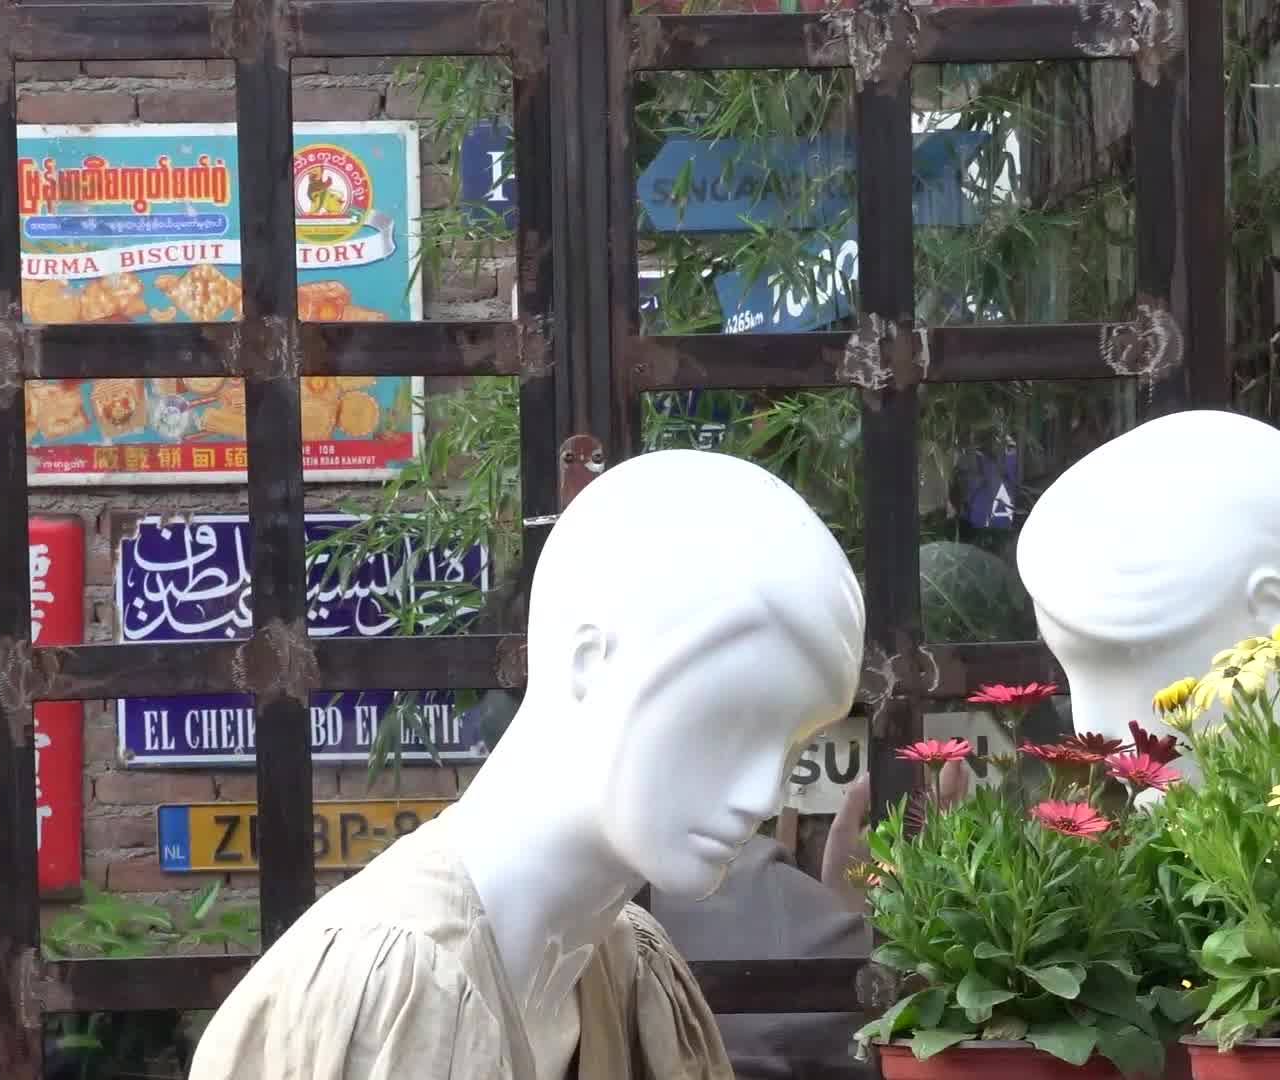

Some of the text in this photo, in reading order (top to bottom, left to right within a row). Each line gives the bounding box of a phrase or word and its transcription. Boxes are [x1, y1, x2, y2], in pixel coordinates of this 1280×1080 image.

[21, 243, 366, 276] URMA BISCUIT TORY
[144, 710, 176, 751] EL
[312, 705, 343, 747] BD
[163, 847, 185, 860] NL
